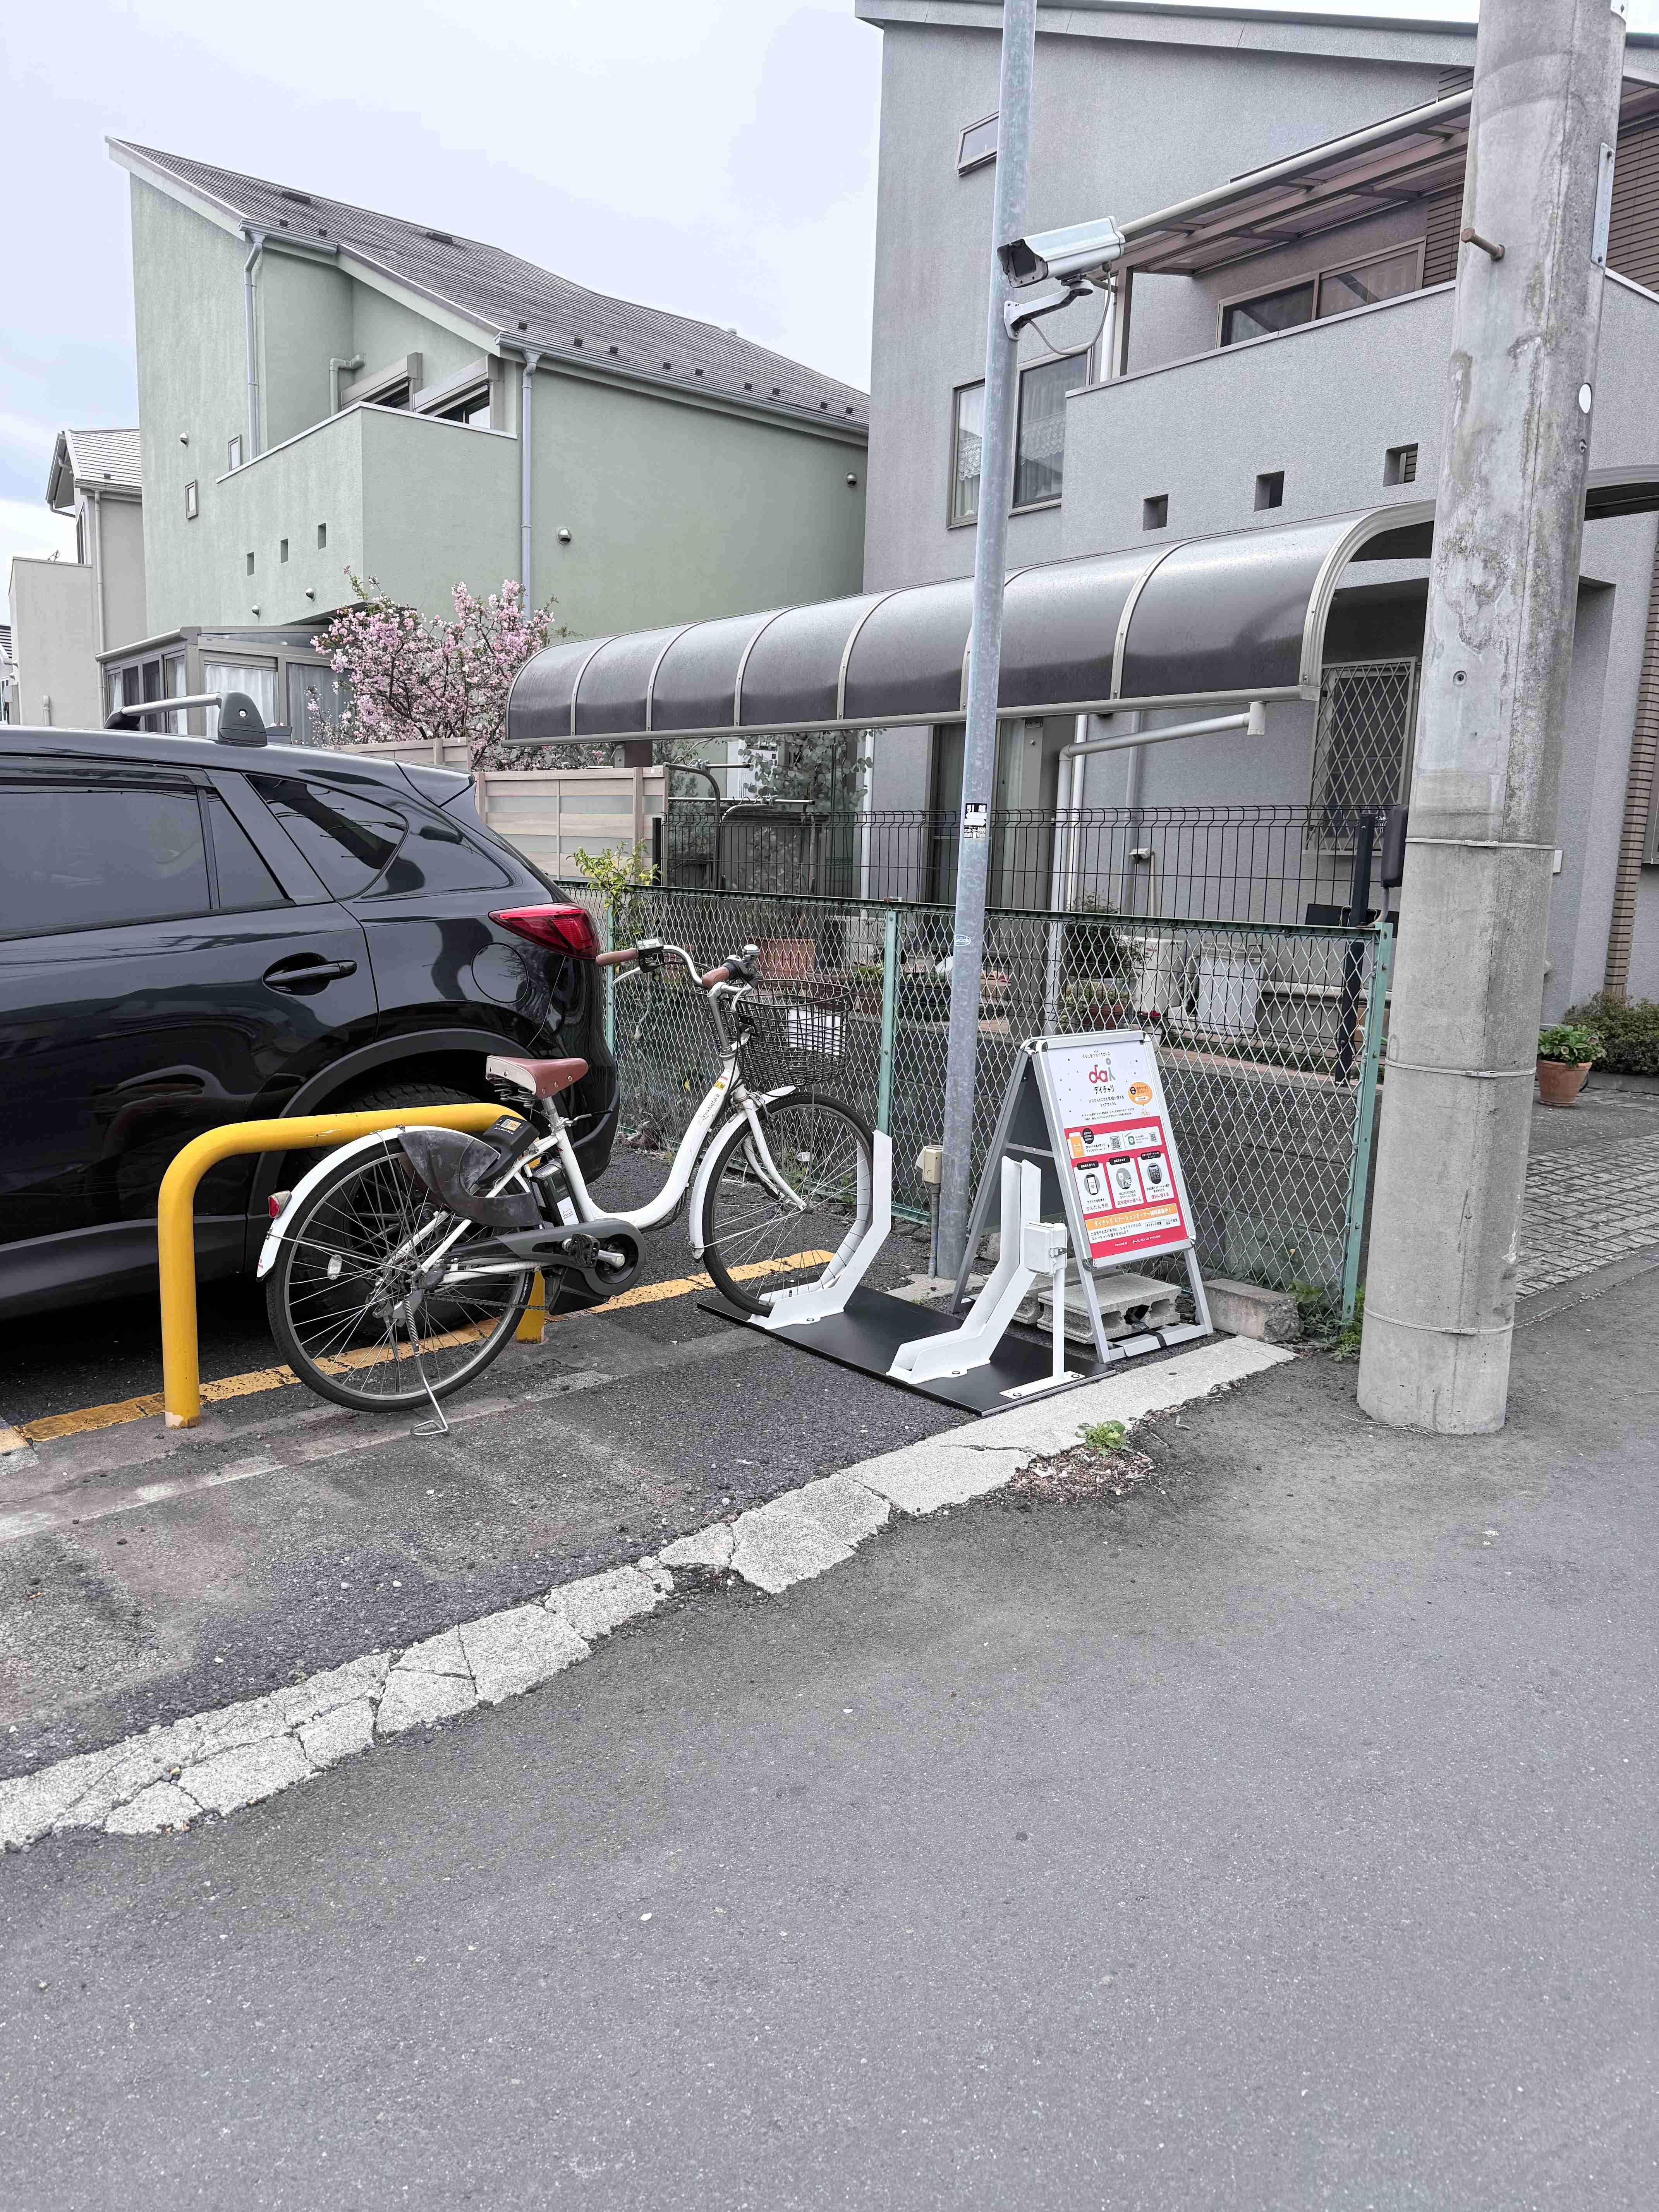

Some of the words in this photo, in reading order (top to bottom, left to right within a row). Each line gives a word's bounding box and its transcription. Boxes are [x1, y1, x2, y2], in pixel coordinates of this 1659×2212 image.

[1089, 1058, 1116, 1084] dai
[1094, 1085, 1114, 1094] ダイチャリ
[1094, 1217, 1113, 1227] ダイチャリ
